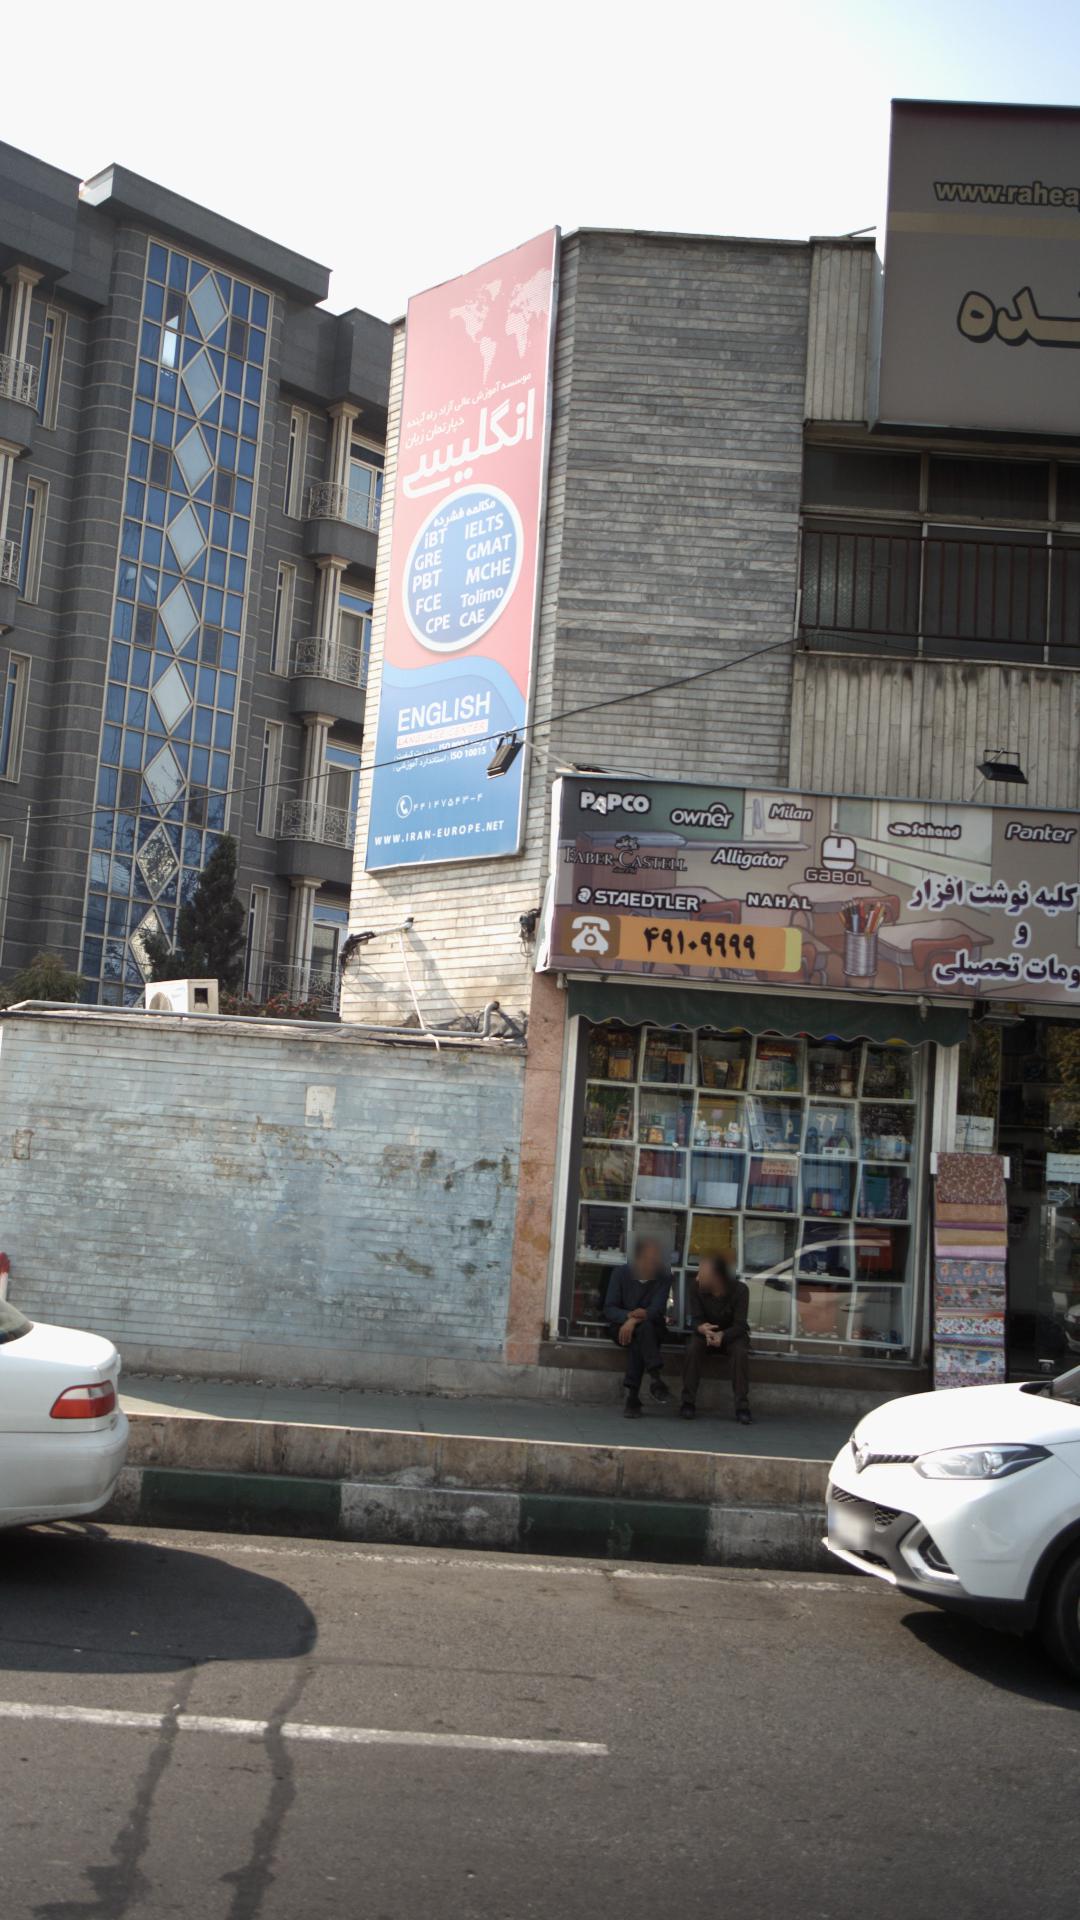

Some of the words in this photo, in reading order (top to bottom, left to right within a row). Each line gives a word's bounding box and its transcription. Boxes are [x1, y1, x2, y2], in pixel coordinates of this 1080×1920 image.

[472, 381, 500, 404] آموزش
[501, 373, 531, 389] موسسه
[405, 429, 425, 448] زبان
[426, 416, 464, 440] دپارتمان
[403, 388, 535, 498] انگلیسی
[434, 507, 464, 527] فشرده
[466, 498, 496, 516] مکالمه
[424, 528, 448, 549] iBT
[465, 513, 504, 540] IELTS
[414, 549, 442, 571] GRE
[466, 534, 512, 561] GMAT
[413, 569, 442, 592] PBT
[465, 557, 512, 585] MCHE
[416, 593, 442, 615] FCE
[461, 587, 504, 608] Tolimo
[425, 614, 450, 633] CPE
[459, 608, 485, 628] CAE
[398, 691, 491, 732] ENGLISH
[450, 751, 463, 760] ISO
[465, 746, 486, 758] 10015
[581, 791, 650, 815] PAPCO
[770, 805, 813, 821] Milan
[671, 804, 734, 828] owner
[374, 820, 504, 846] WWW.IRAN-EUROPE.NET
[912, 822, 961, 840] Sahand
[1006, 823, 1075, 842] Panter
[713, 850, 787, 869] Alligator
[595, 890, 699, 911] STAEDTLER
[748, 894, 812, 910] NAHAL
[910, 877, 963, 908] افزار
[969, 883, 1028, 912] نوشت
[1036, 886, 1077, 913] کلیه
[644, 926, 756, 959] ۴۹۱۰۹۹۹۹
[1016, 924, 1028, 944] و
[936, 953, 1020, 982] تحصیلی
